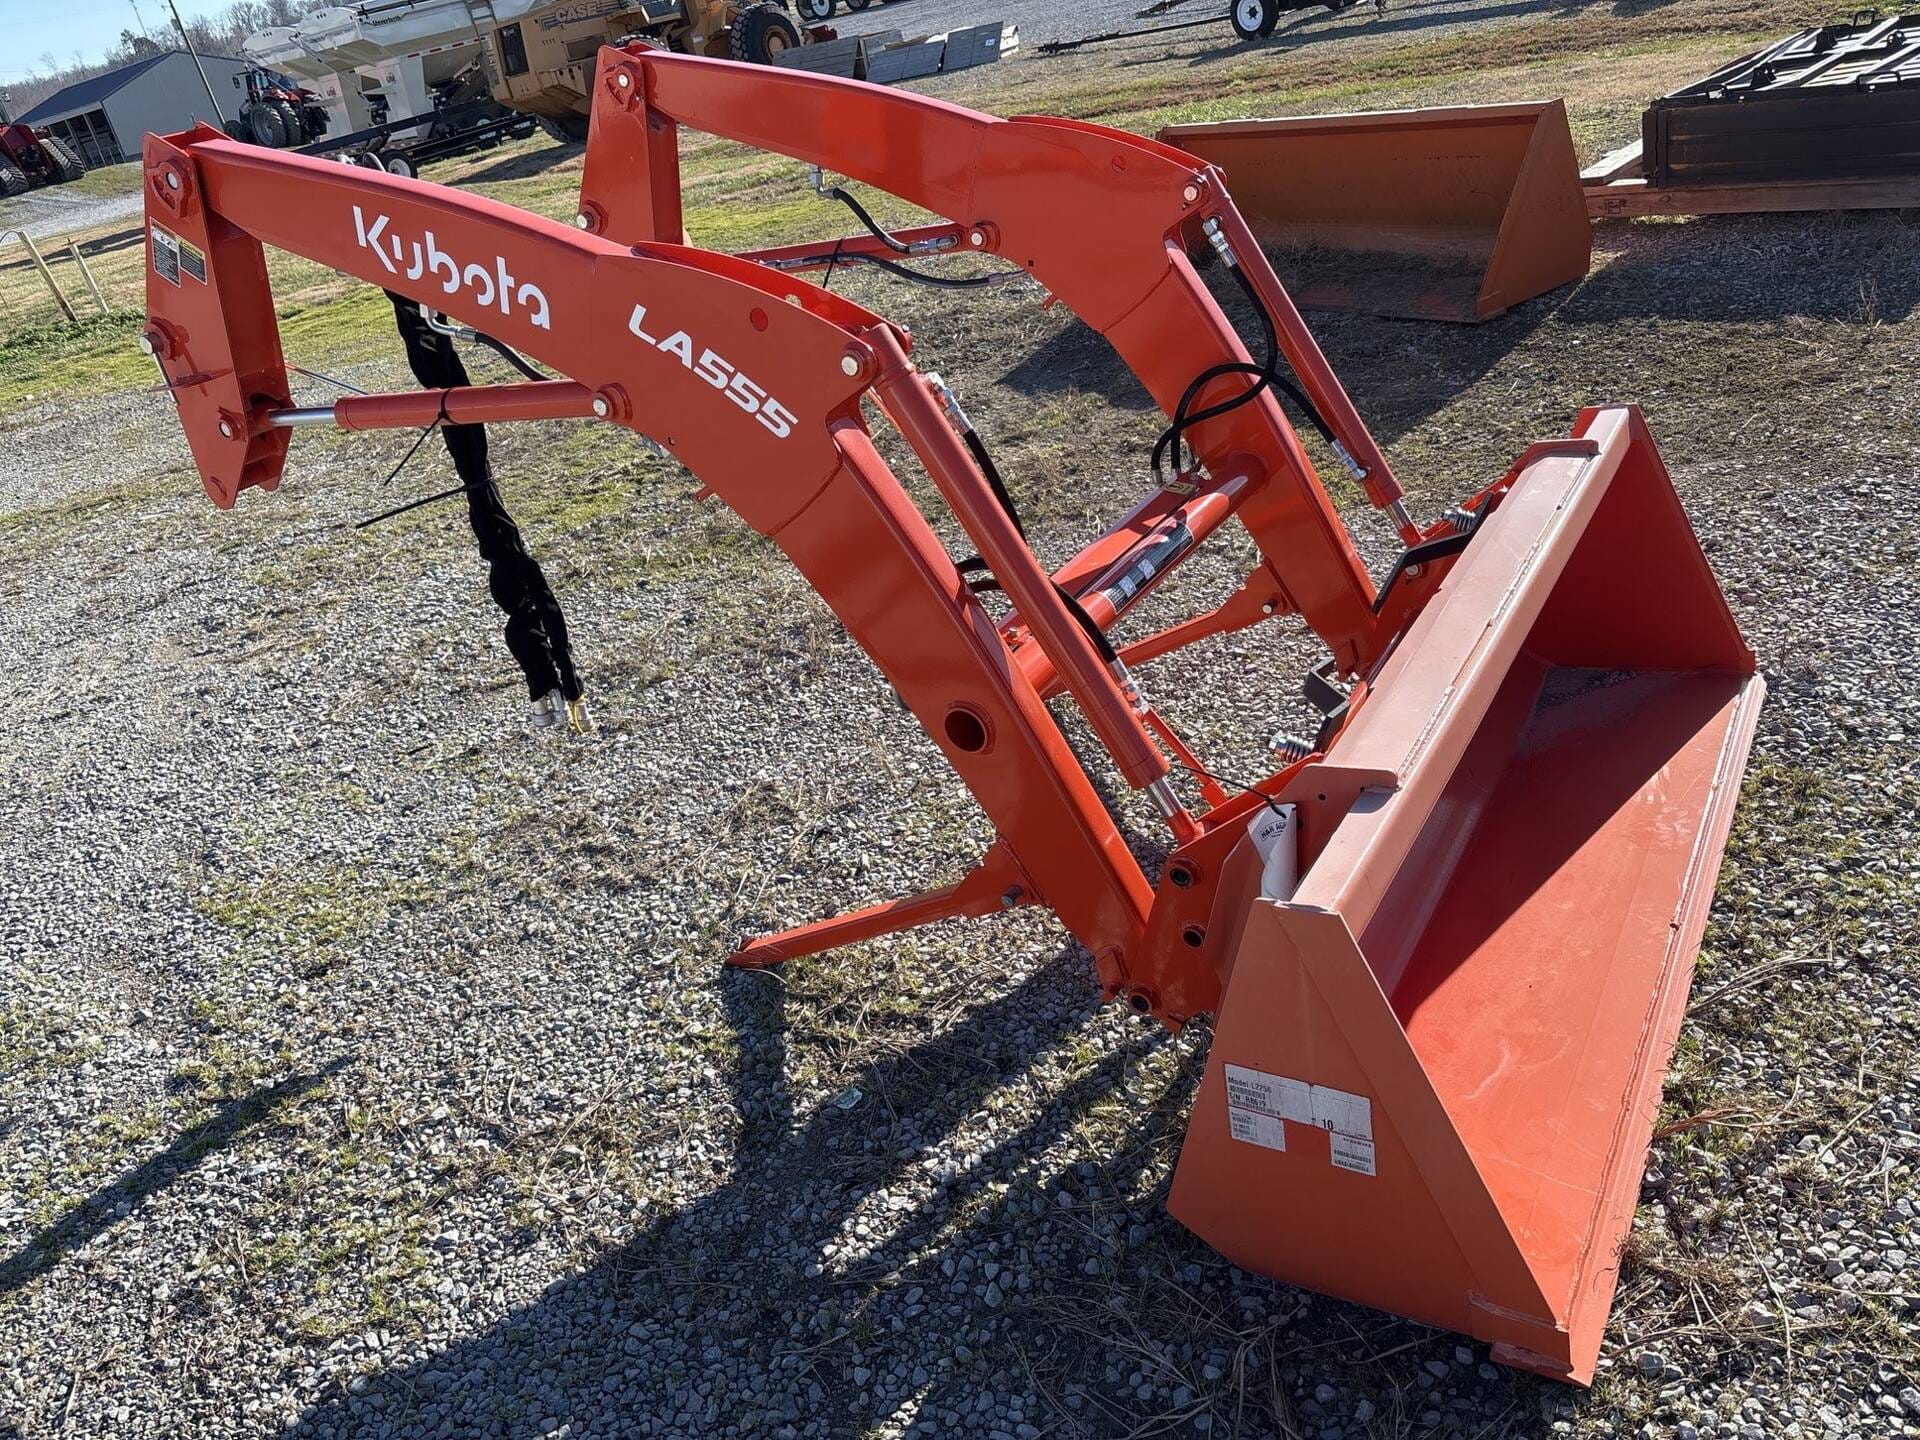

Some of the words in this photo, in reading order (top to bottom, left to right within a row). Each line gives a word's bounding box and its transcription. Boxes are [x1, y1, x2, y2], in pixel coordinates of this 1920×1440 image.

[555, 2, 598, 22] CASE
[353, 205, 551, 330] Kubota
[628, 303, 799, 439] LA555
[1261, 825, 1275, 839] H&R
[1228, 1076, 1249, 1088] Model
